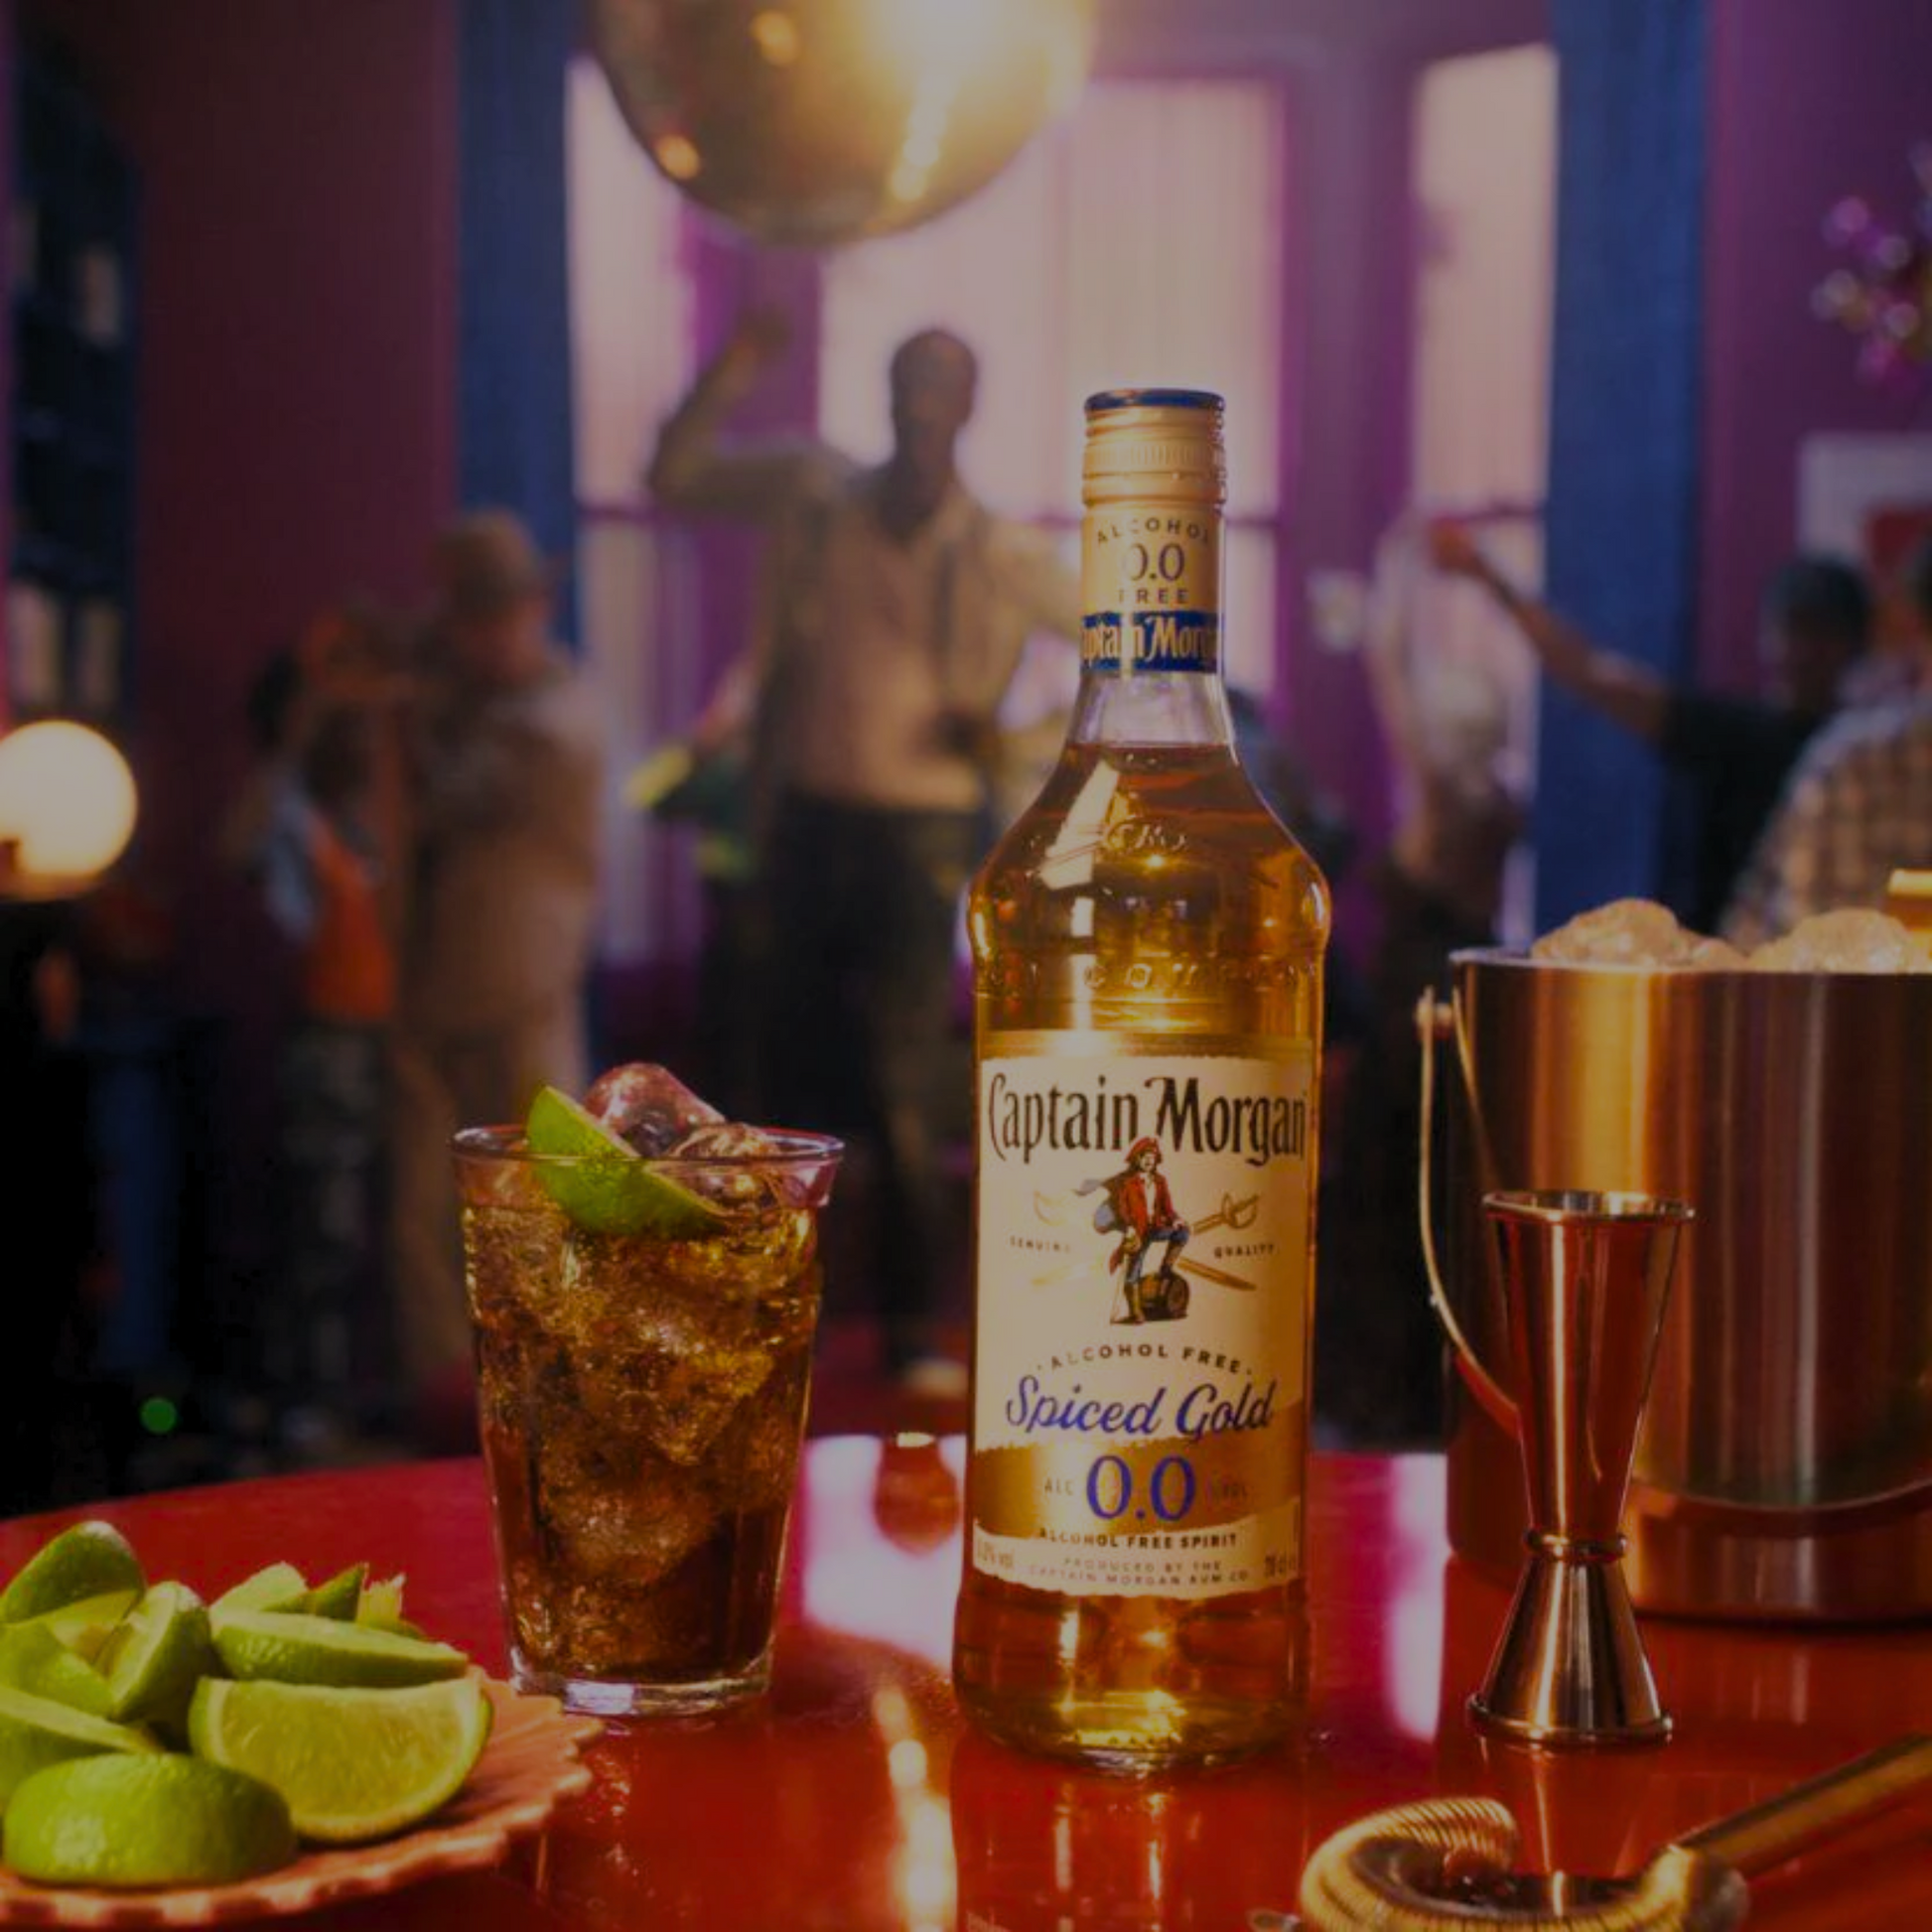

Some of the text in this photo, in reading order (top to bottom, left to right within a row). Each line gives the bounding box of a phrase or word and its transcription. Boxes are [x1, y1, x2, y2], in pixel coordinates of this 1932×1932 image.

[989, 1072, 1307, 1167] Captain Morgan
[1050, 1343, 1241, 1374] ALCOHOL FREE
[1006, 1374, 1277, 1445] Spiced Gold
[1086, 1454, 1197, 1522] 0.0
[1038, 1527, 1237, 1549] ALCOHOL FREE SPIRIT
